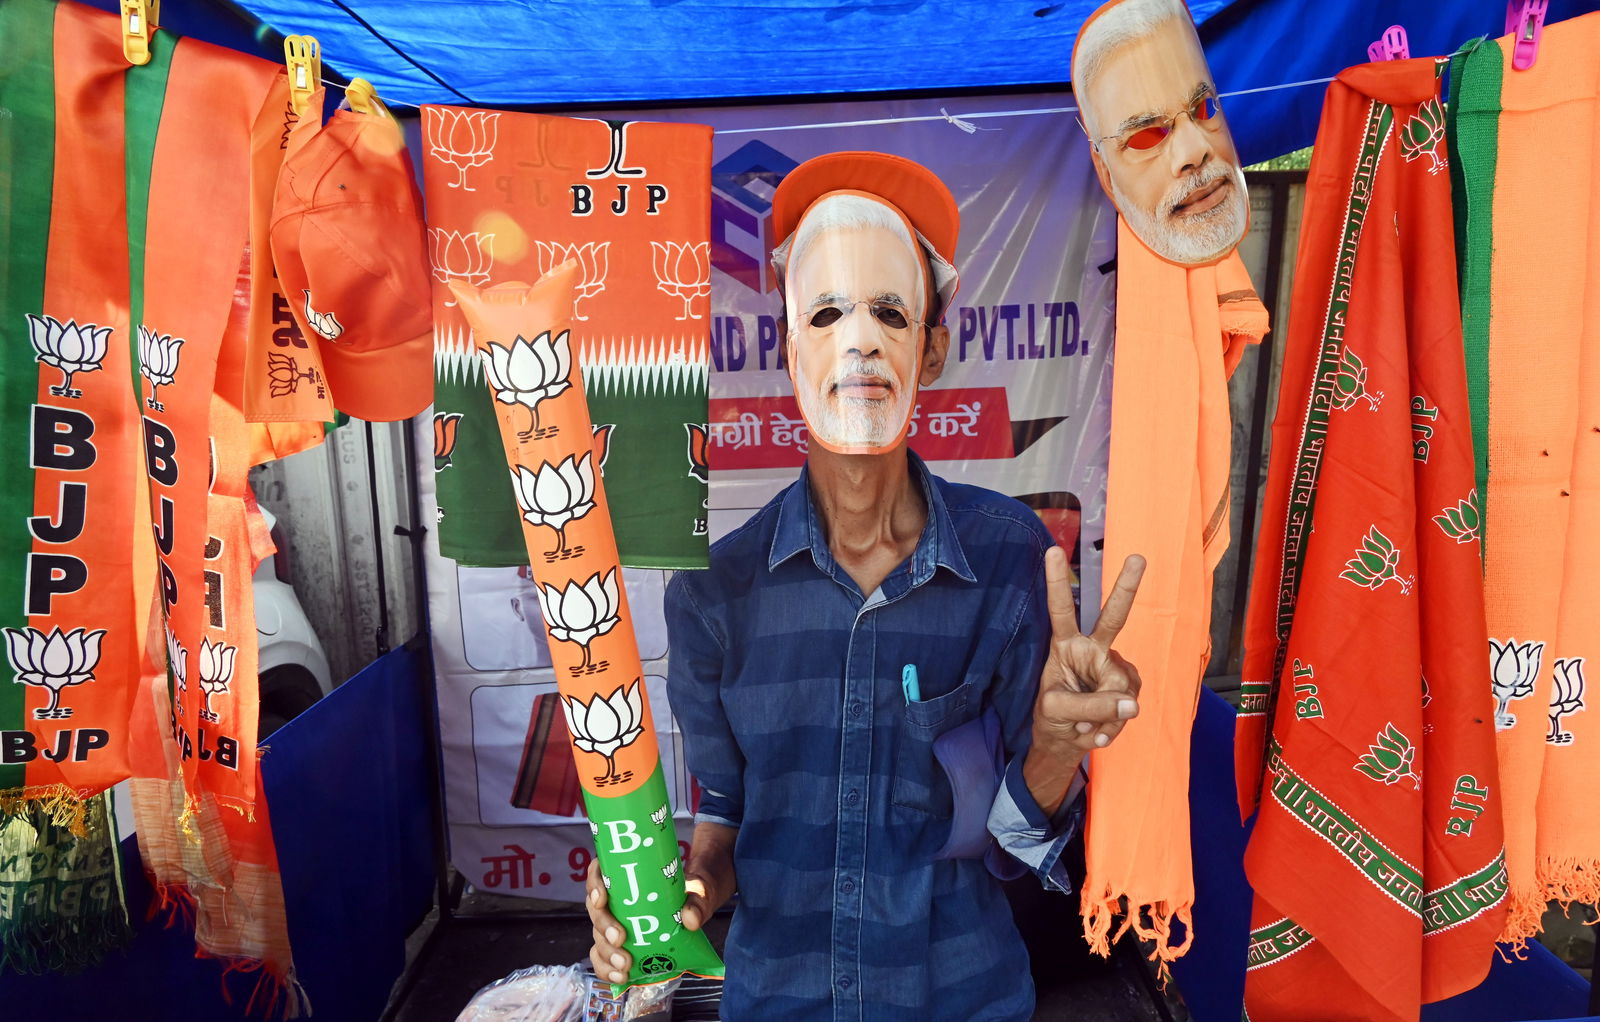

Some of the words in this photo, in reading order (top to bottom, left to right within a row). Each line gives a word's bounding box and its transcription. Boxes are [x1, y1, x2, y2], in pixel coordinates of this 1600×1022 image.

[709, 315, 747, 373] ND
[709, 412, 763, 451] मग्री
[928, 401, 982, 438] करें
[1293, 657, 1325, 722] BJP
[0, 727, 110, 766] BJP
[1305, 800, 1379, 867] भारतीय
